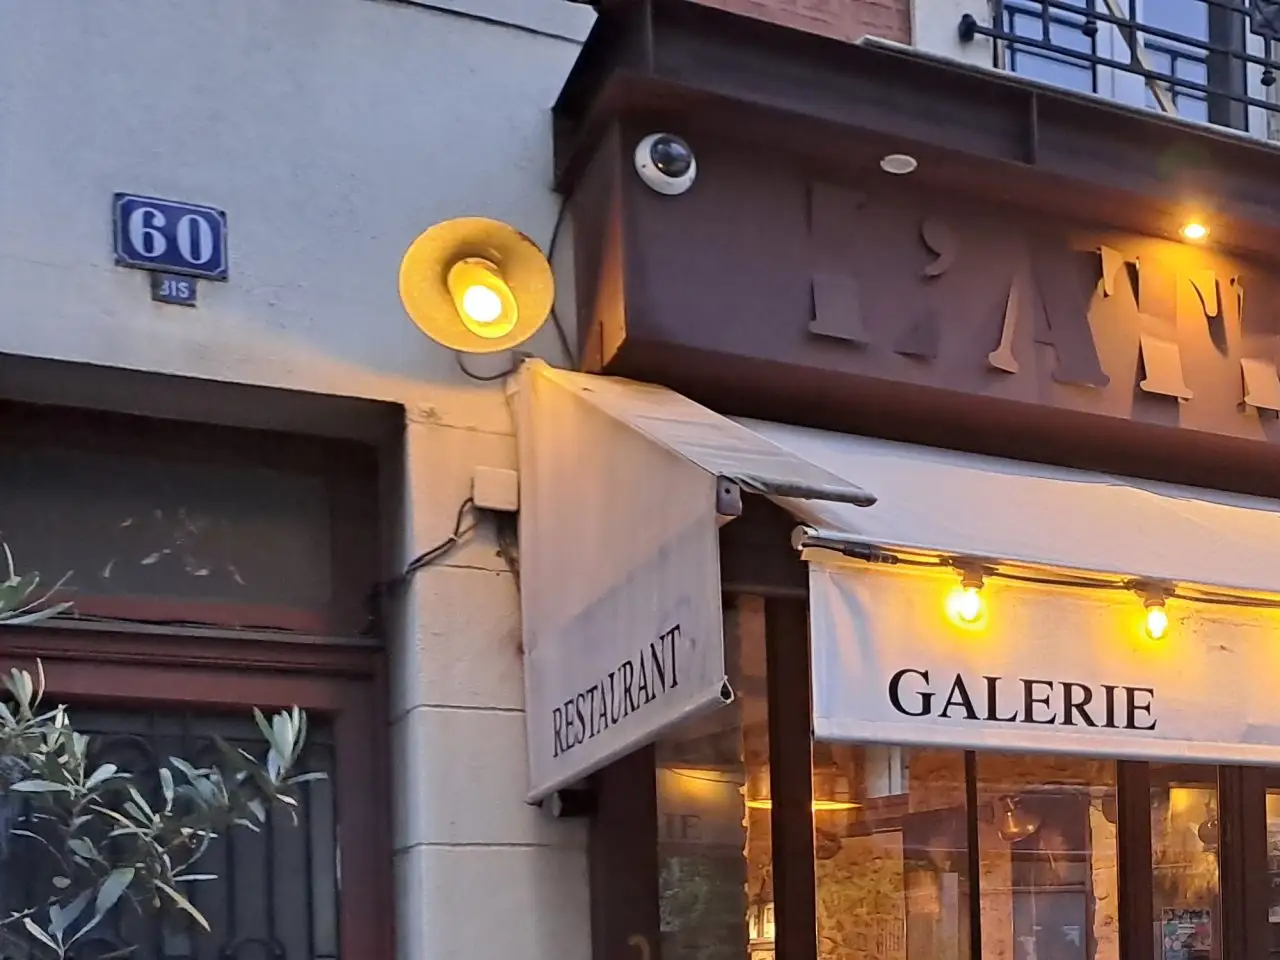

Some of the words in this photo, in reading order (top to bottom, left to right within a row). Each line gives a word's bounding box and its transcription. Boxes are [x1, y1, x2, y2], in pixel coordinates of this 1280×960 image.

[129, 206, 214, 265] 60
[552, 623, 682, 759] RESTAURANT
[887, 667, 1158, 732] GALERIE
